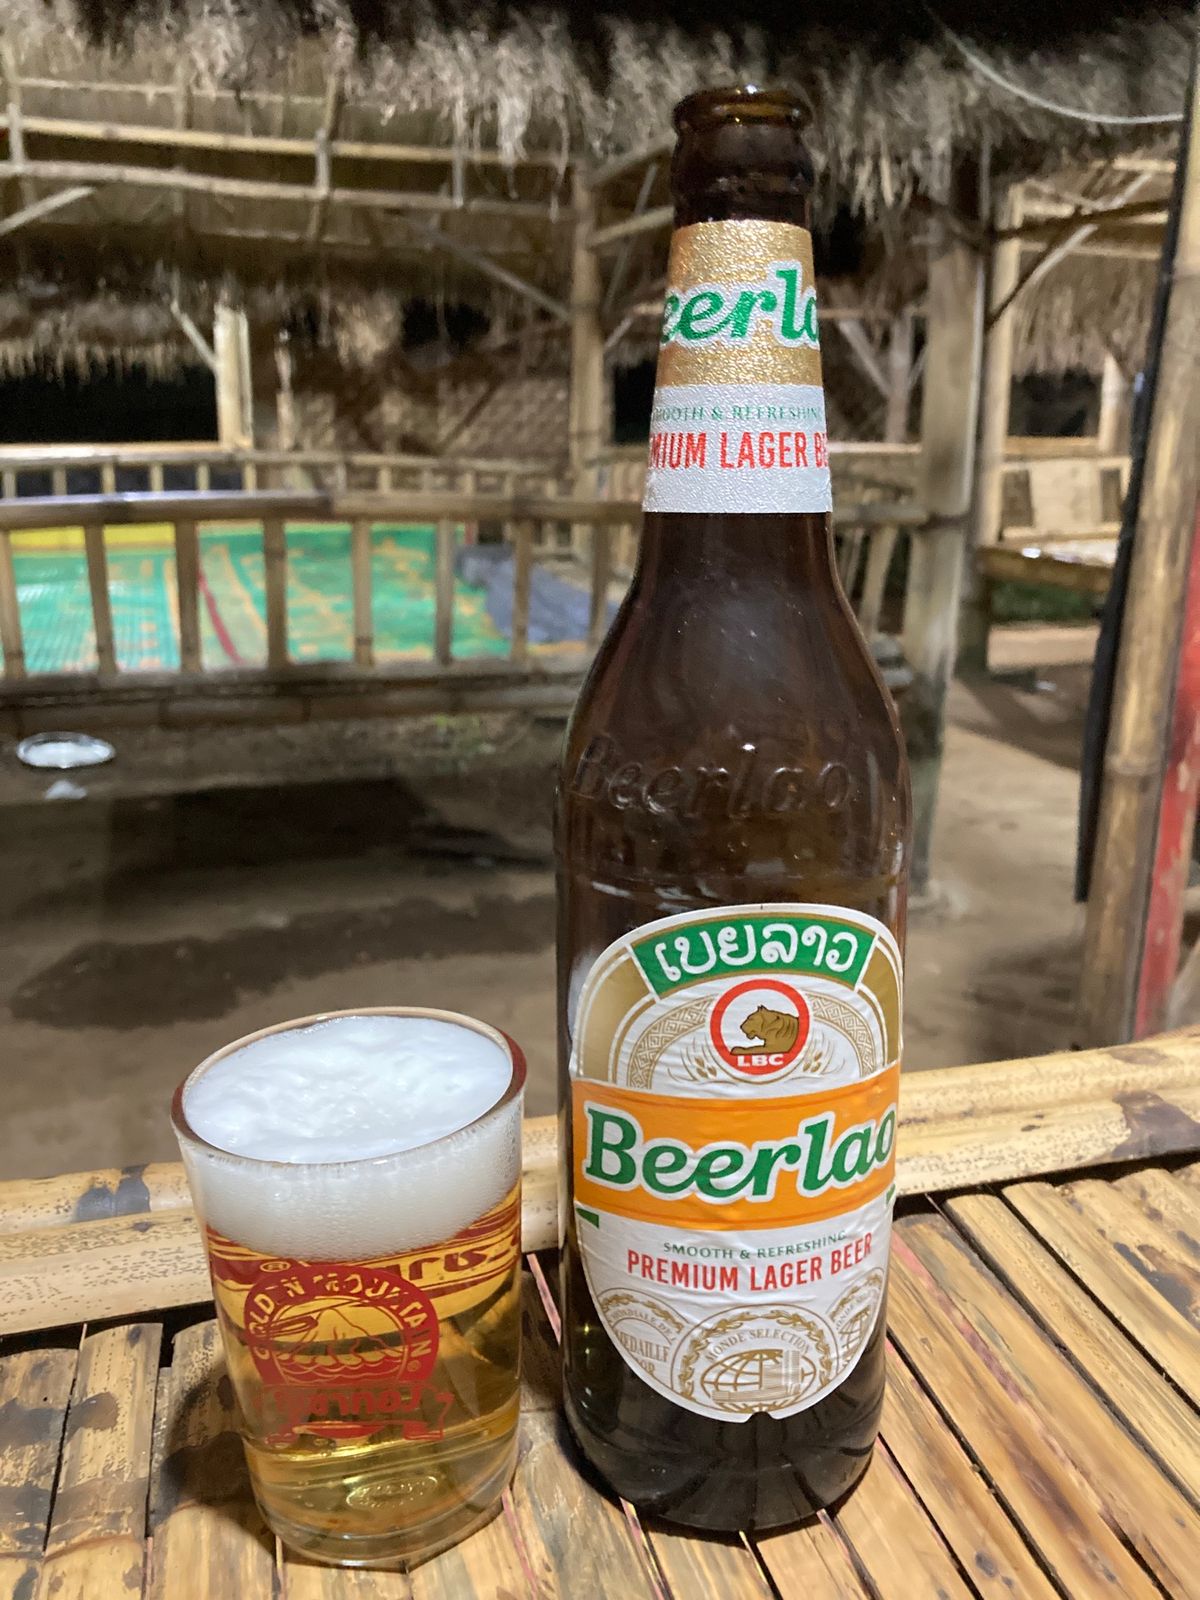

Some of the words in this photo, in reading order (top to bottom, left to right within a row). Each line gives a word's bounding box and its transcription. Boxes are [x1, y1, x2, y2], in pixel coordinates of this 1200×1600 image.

[711, 406, 724, 421] &
[720, 431, 808, 469] LAGER
[654, 922, 859, 983] ເບຍລາວ
[737, 1053, 784, 1068] LBC
[585, 1107, 896, 1199] Beerlao
[627, 1248, 739, 1292] PREMIUM
[750, 1256, 823, 1292] LAGER
[830, 1232, 873, 1276] BEER
[663, 1241, 734, 1260] SMOOTH
[739, 1248, 751, 1260] &
[756, 1230, 847, 1259] REFRESHING
[704, 1332, 746, 1361] MONDE
[748, 1328, 809, 1355] SELECTION
